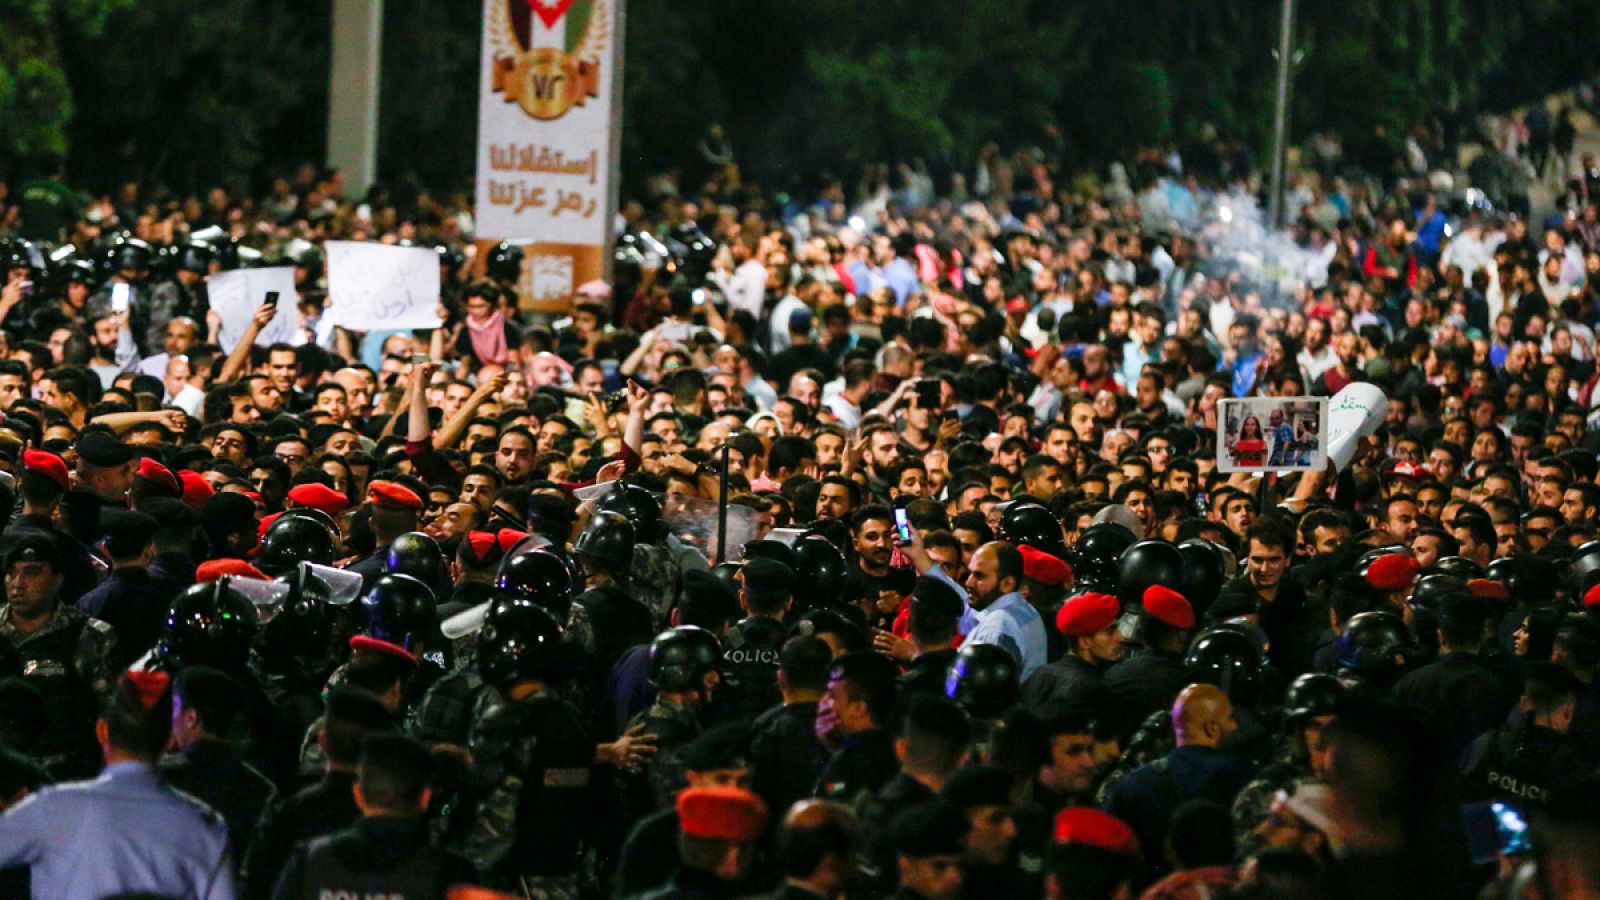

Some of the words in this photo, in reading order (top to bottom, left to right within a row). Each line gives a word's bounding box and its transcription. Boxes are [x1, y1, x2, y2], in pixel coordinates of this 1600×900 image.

[488, 143, 598, 185] إستقلالنا
[488, 178, 546, 215] عزتنا
[549, 187, 598, 218] رمز
